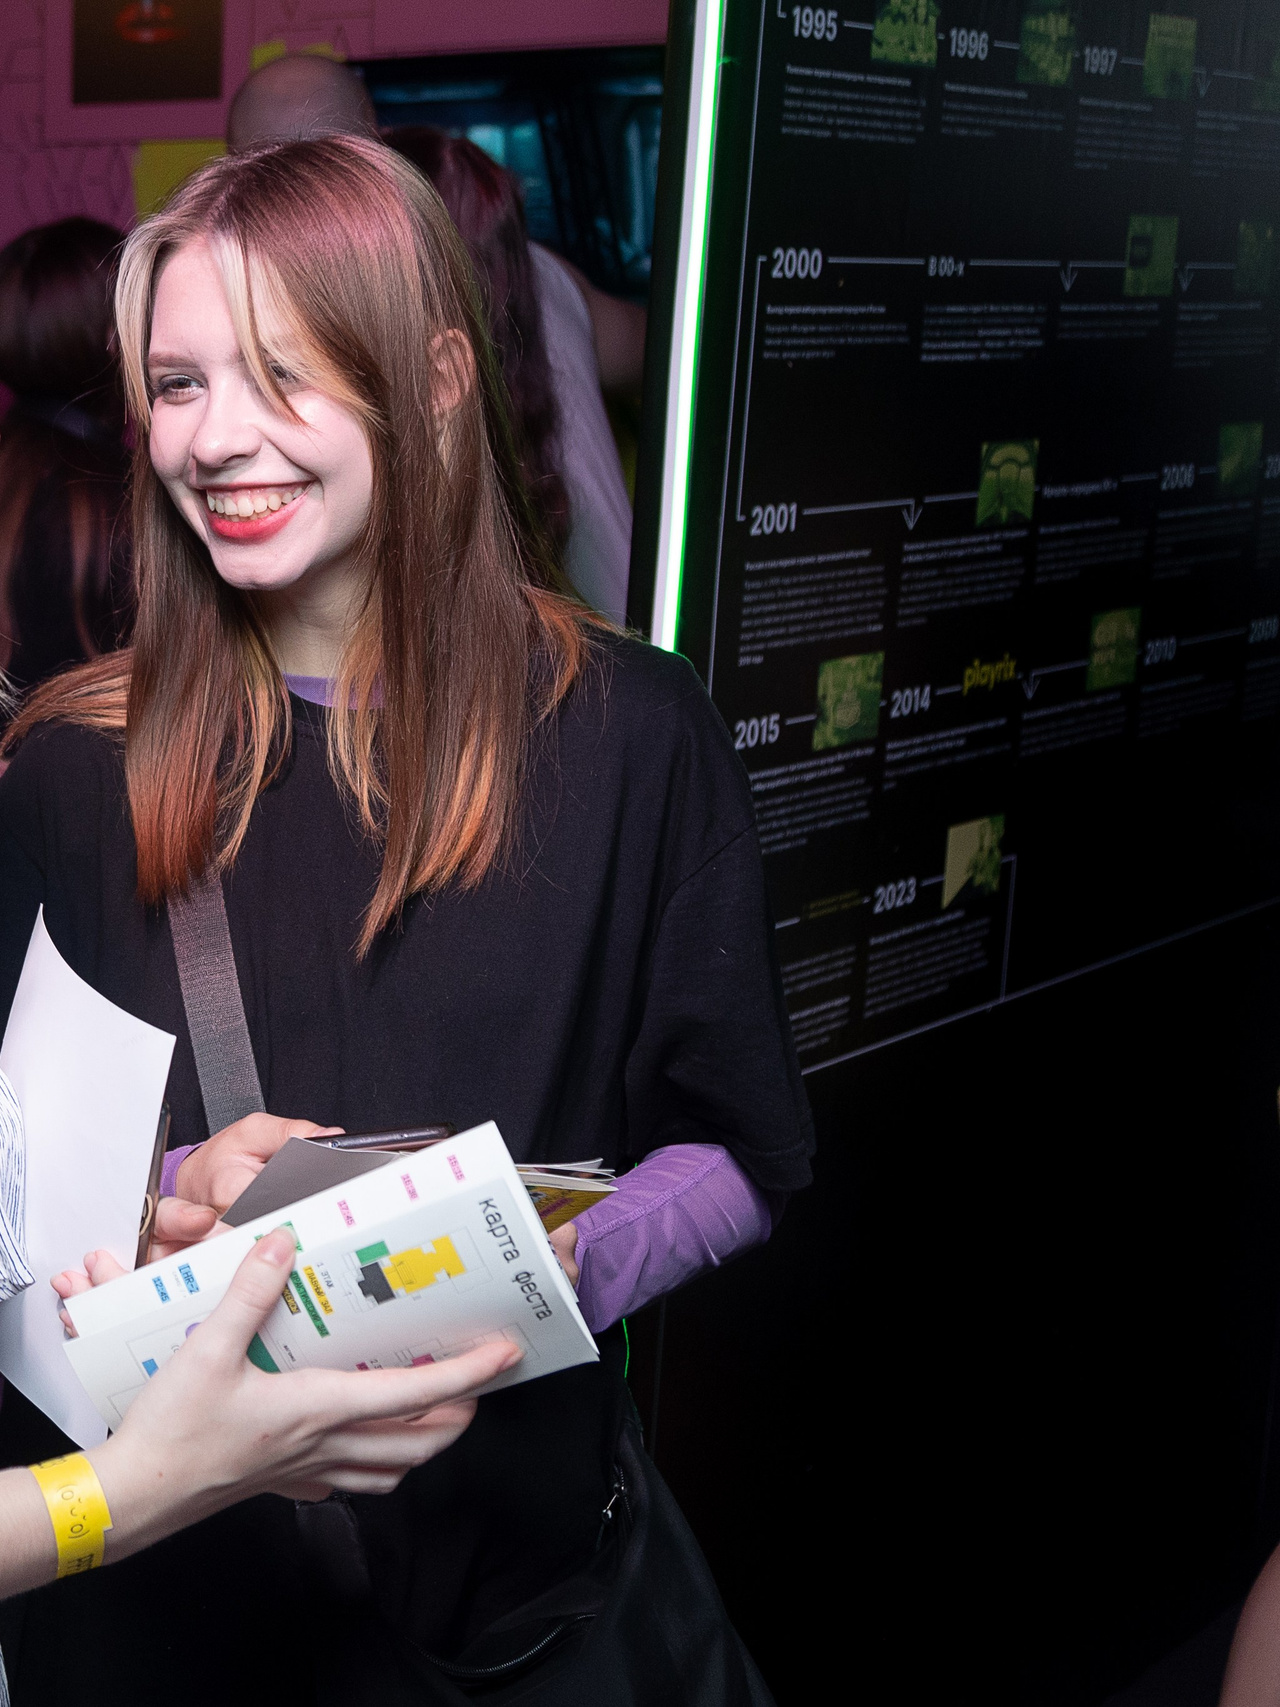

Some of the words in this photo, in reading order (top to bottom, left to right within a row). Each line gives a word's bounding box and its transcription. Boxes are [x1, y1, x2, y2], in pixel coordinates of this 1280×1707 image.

[792, 4, 839, 42] 1995
[949, 26, 989, 61] 1996
[1084, 46, 1118, 75] 1997
[771, 246, 822, 279] 2000
[750, 501, 797, 536] 2001
[1143, 635, 1177, 666] 2010
[962, 651, 1017, 697] playrix
[889, 683, 931, 719] 2014
[734, 713, 781, 750] 2015
[872, 876, 918, 915] 2023
[338, 1200, 355, 1226] 17:45
[479, 1198, 521, 1264] карта
[512, 1270, 553, 1321] феста
[153, 1278, 170, 1302] 12:45
